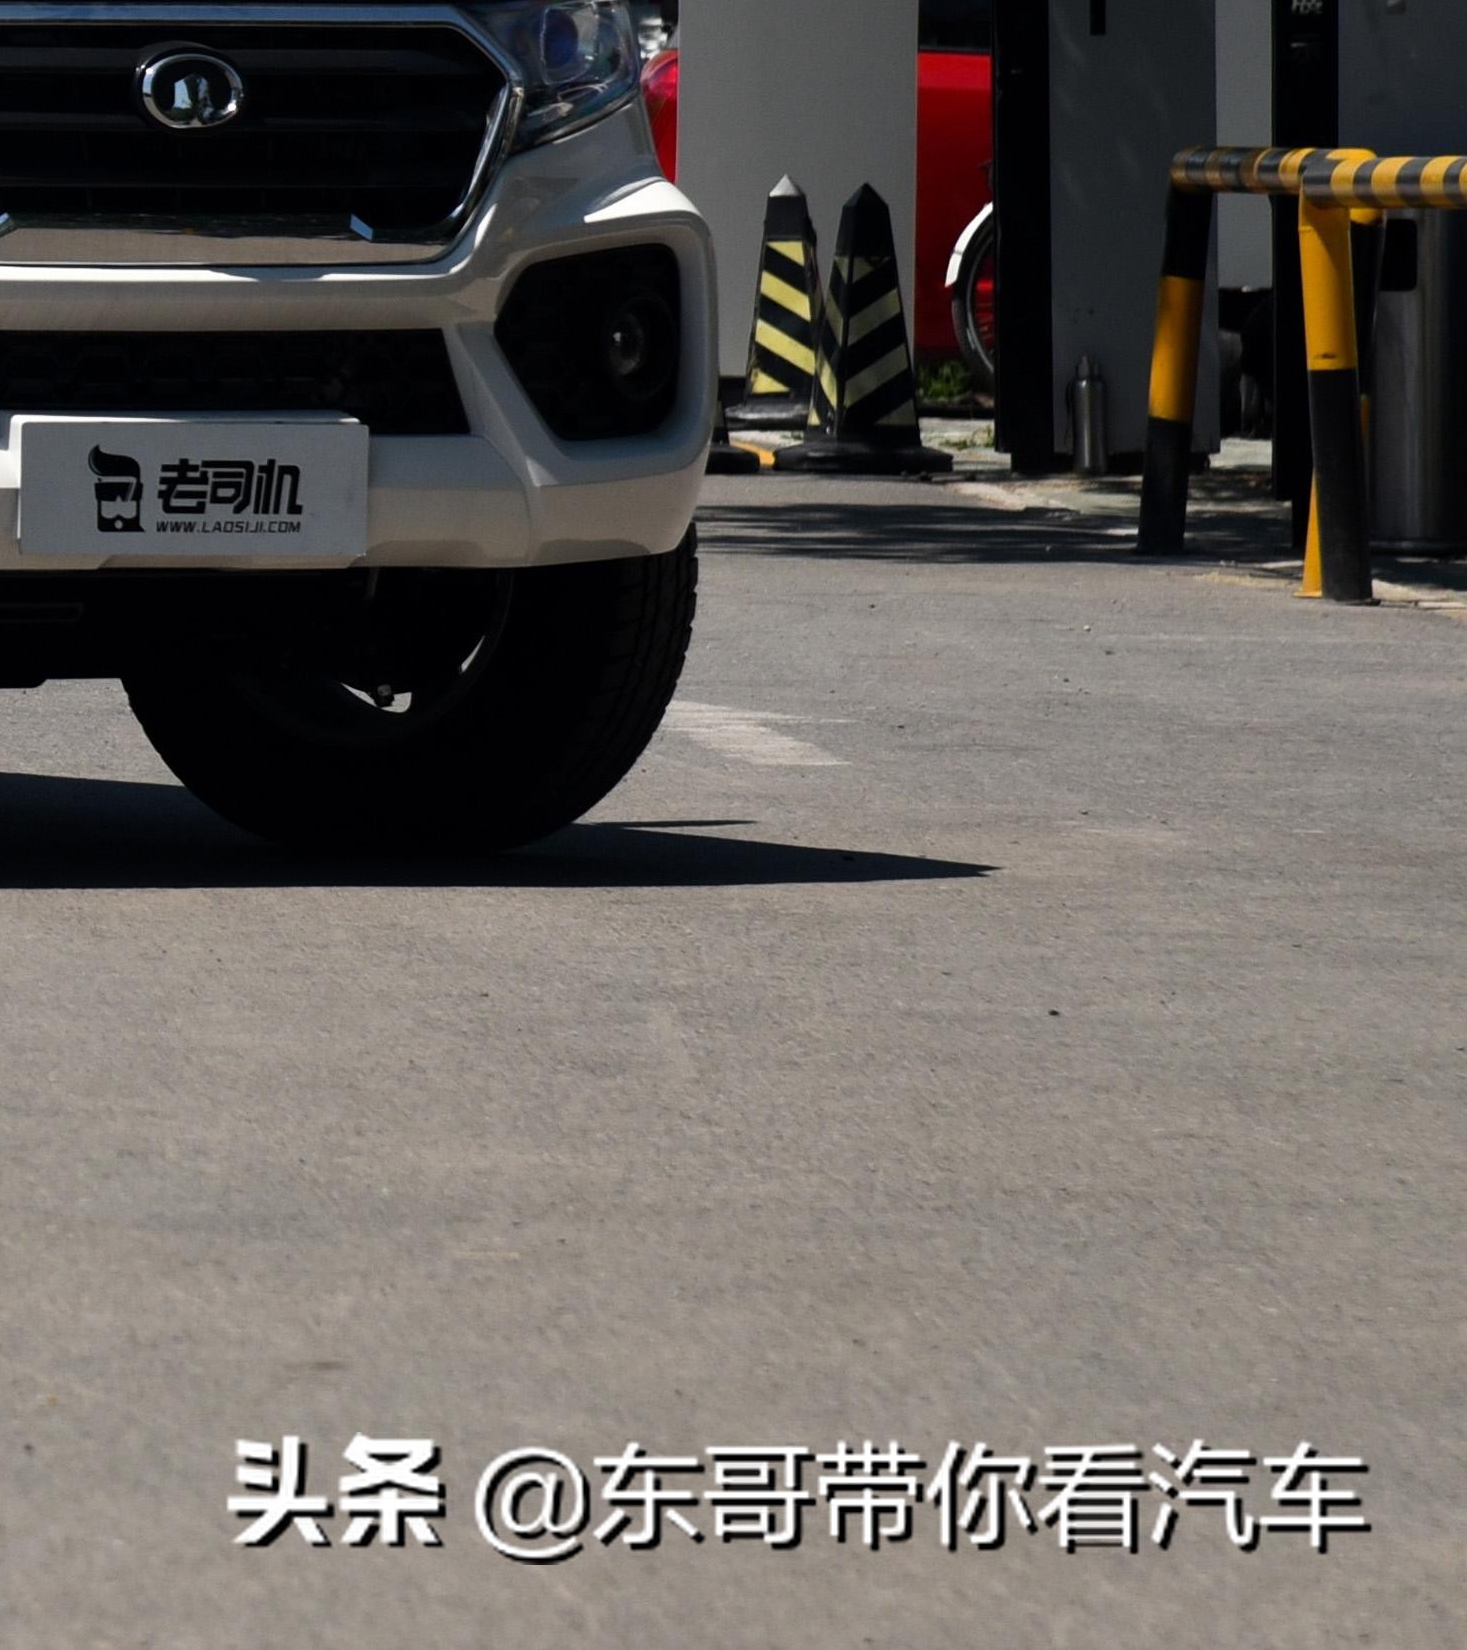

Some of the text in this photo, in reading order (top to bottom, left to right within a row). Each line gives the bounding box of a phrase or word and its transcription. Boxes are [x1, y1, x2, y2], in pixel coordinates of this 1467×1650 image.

[157, 458, 303, 515] 老司机
[156, 520, 302, 534] WWW.LAOSIJI.COM
